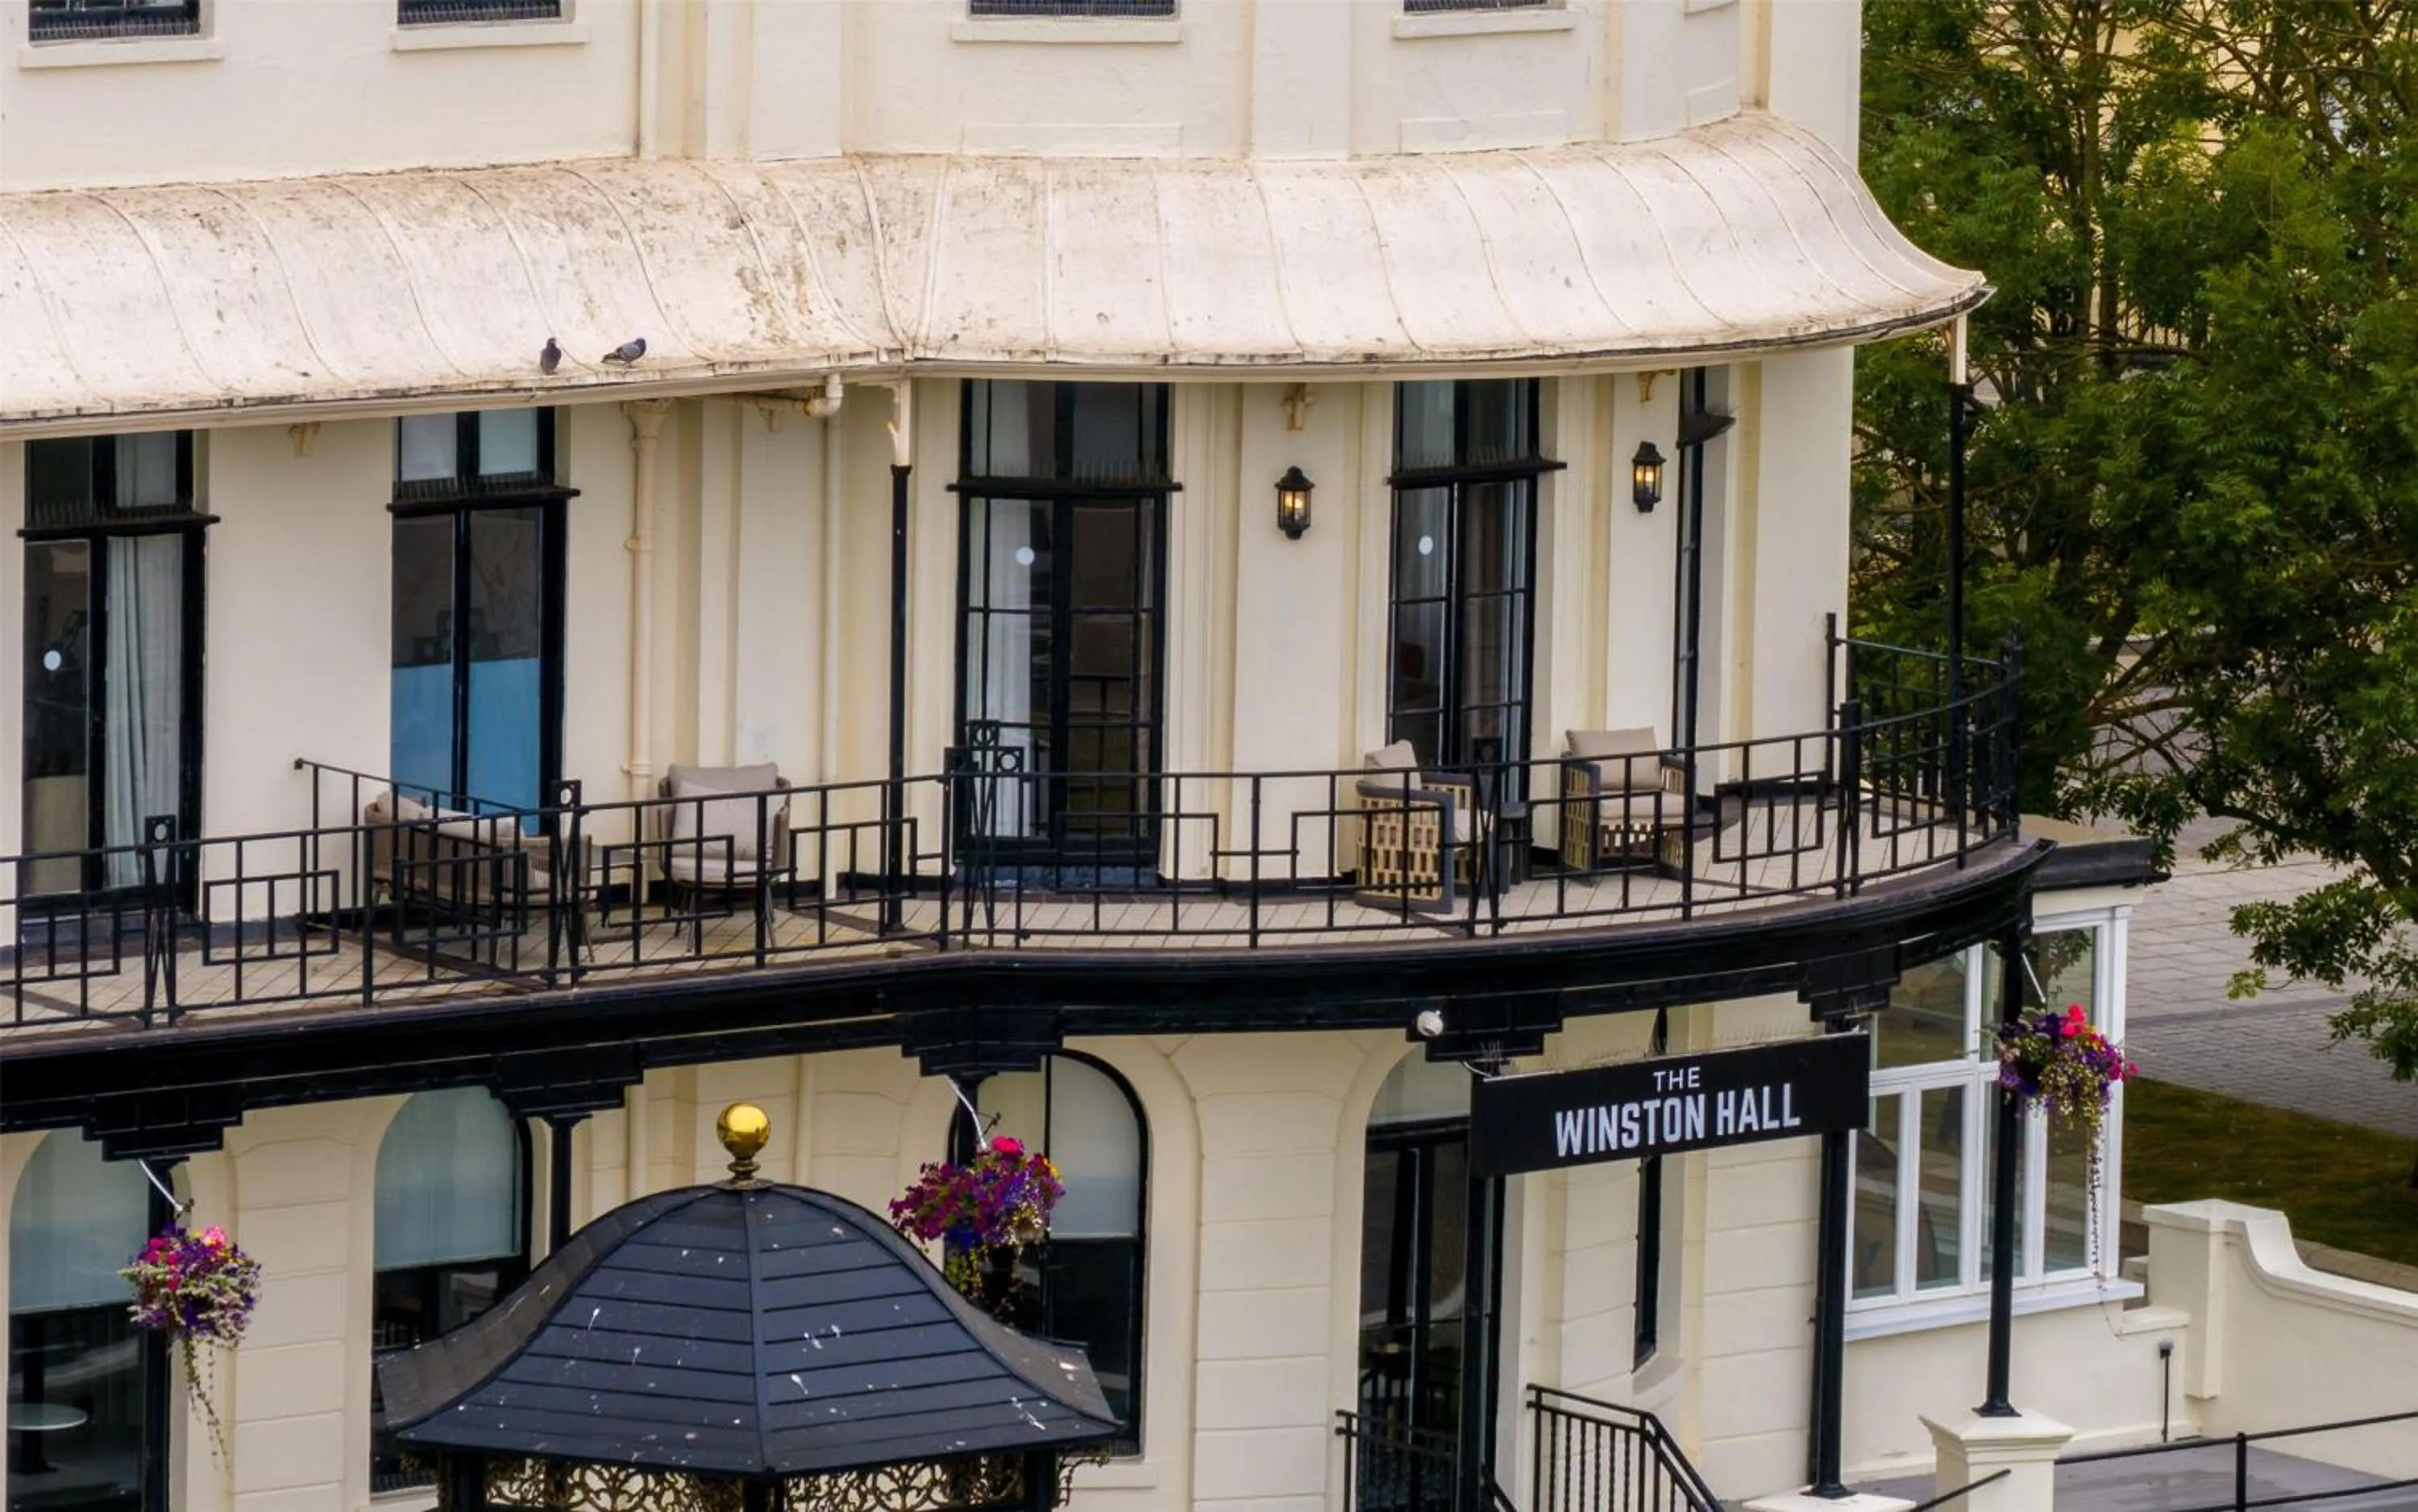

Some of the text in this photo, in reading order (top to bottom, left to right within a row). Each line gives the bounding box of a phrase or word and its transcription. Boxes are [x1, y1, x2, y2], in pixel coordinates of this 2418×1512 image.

[1653, 1066, 1701, 1092] THE
[1555, 1082, 1801, 1157] WINSTON HALL
